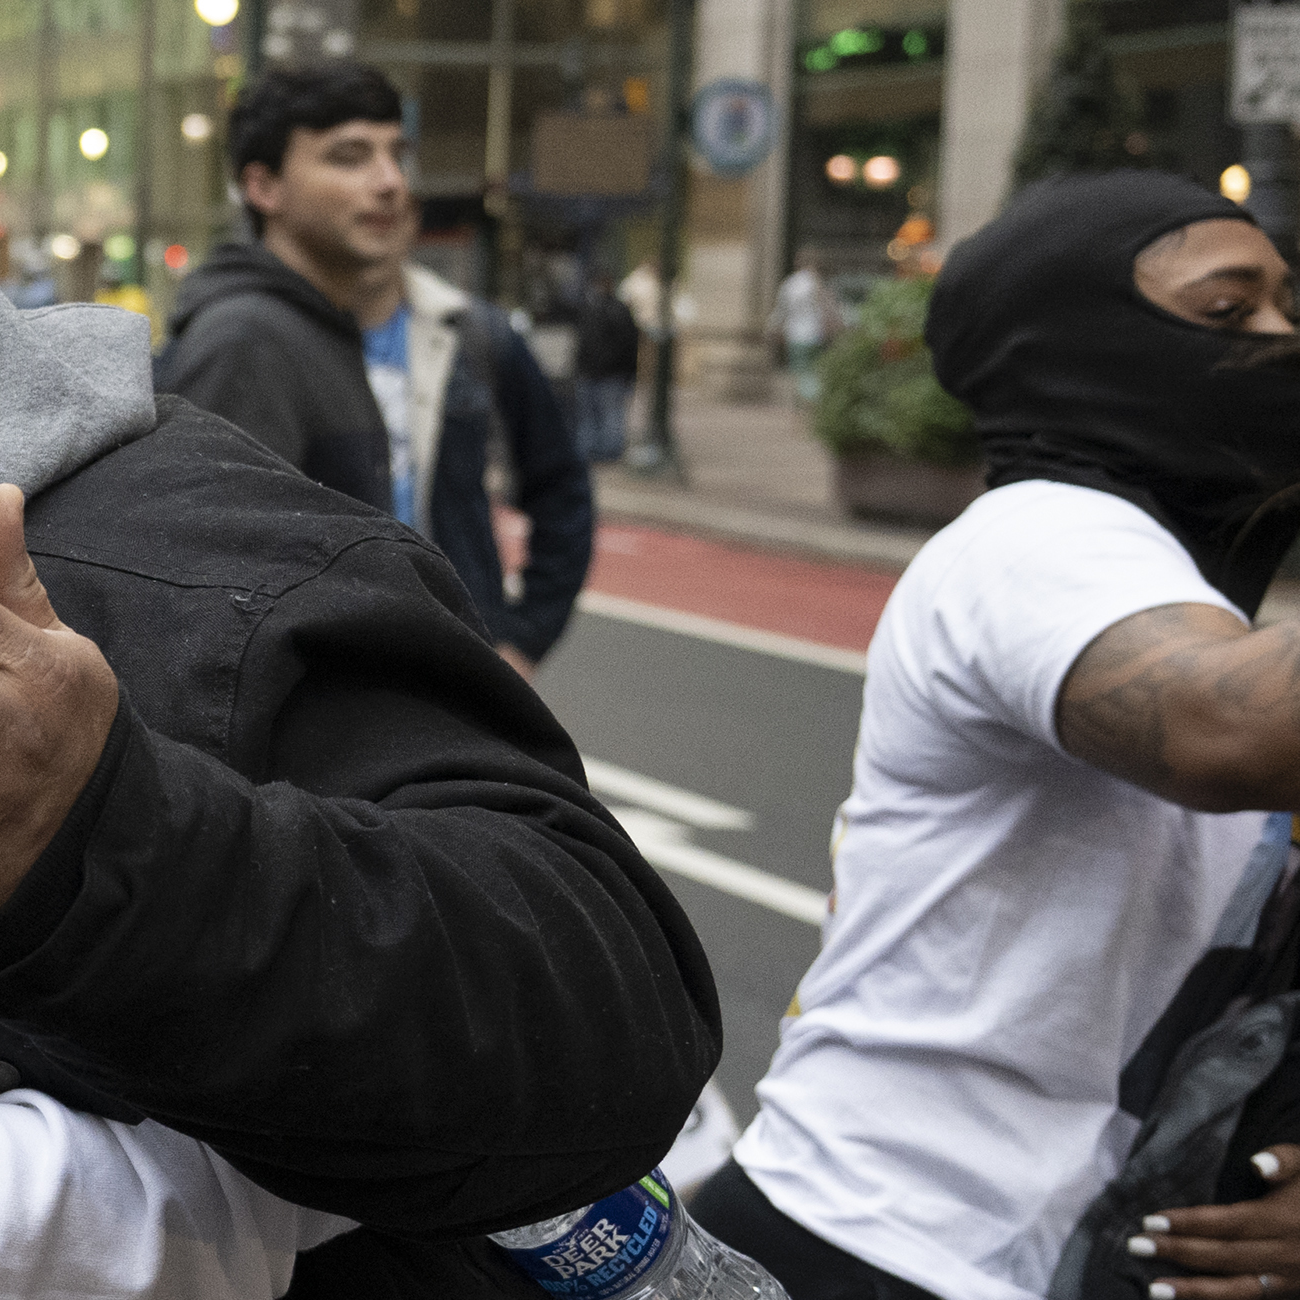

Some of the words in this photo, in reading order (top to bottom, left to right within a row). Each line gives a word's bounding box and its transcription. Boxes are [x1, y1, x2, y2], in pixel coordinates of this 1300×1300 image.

[540, 1218, 615, 1268] DEER
[554, 1230, 631, 1279] PARK
[613, 1272, 636, 1290] NATURAL
[647, 1238, 662, 1258] WATER
